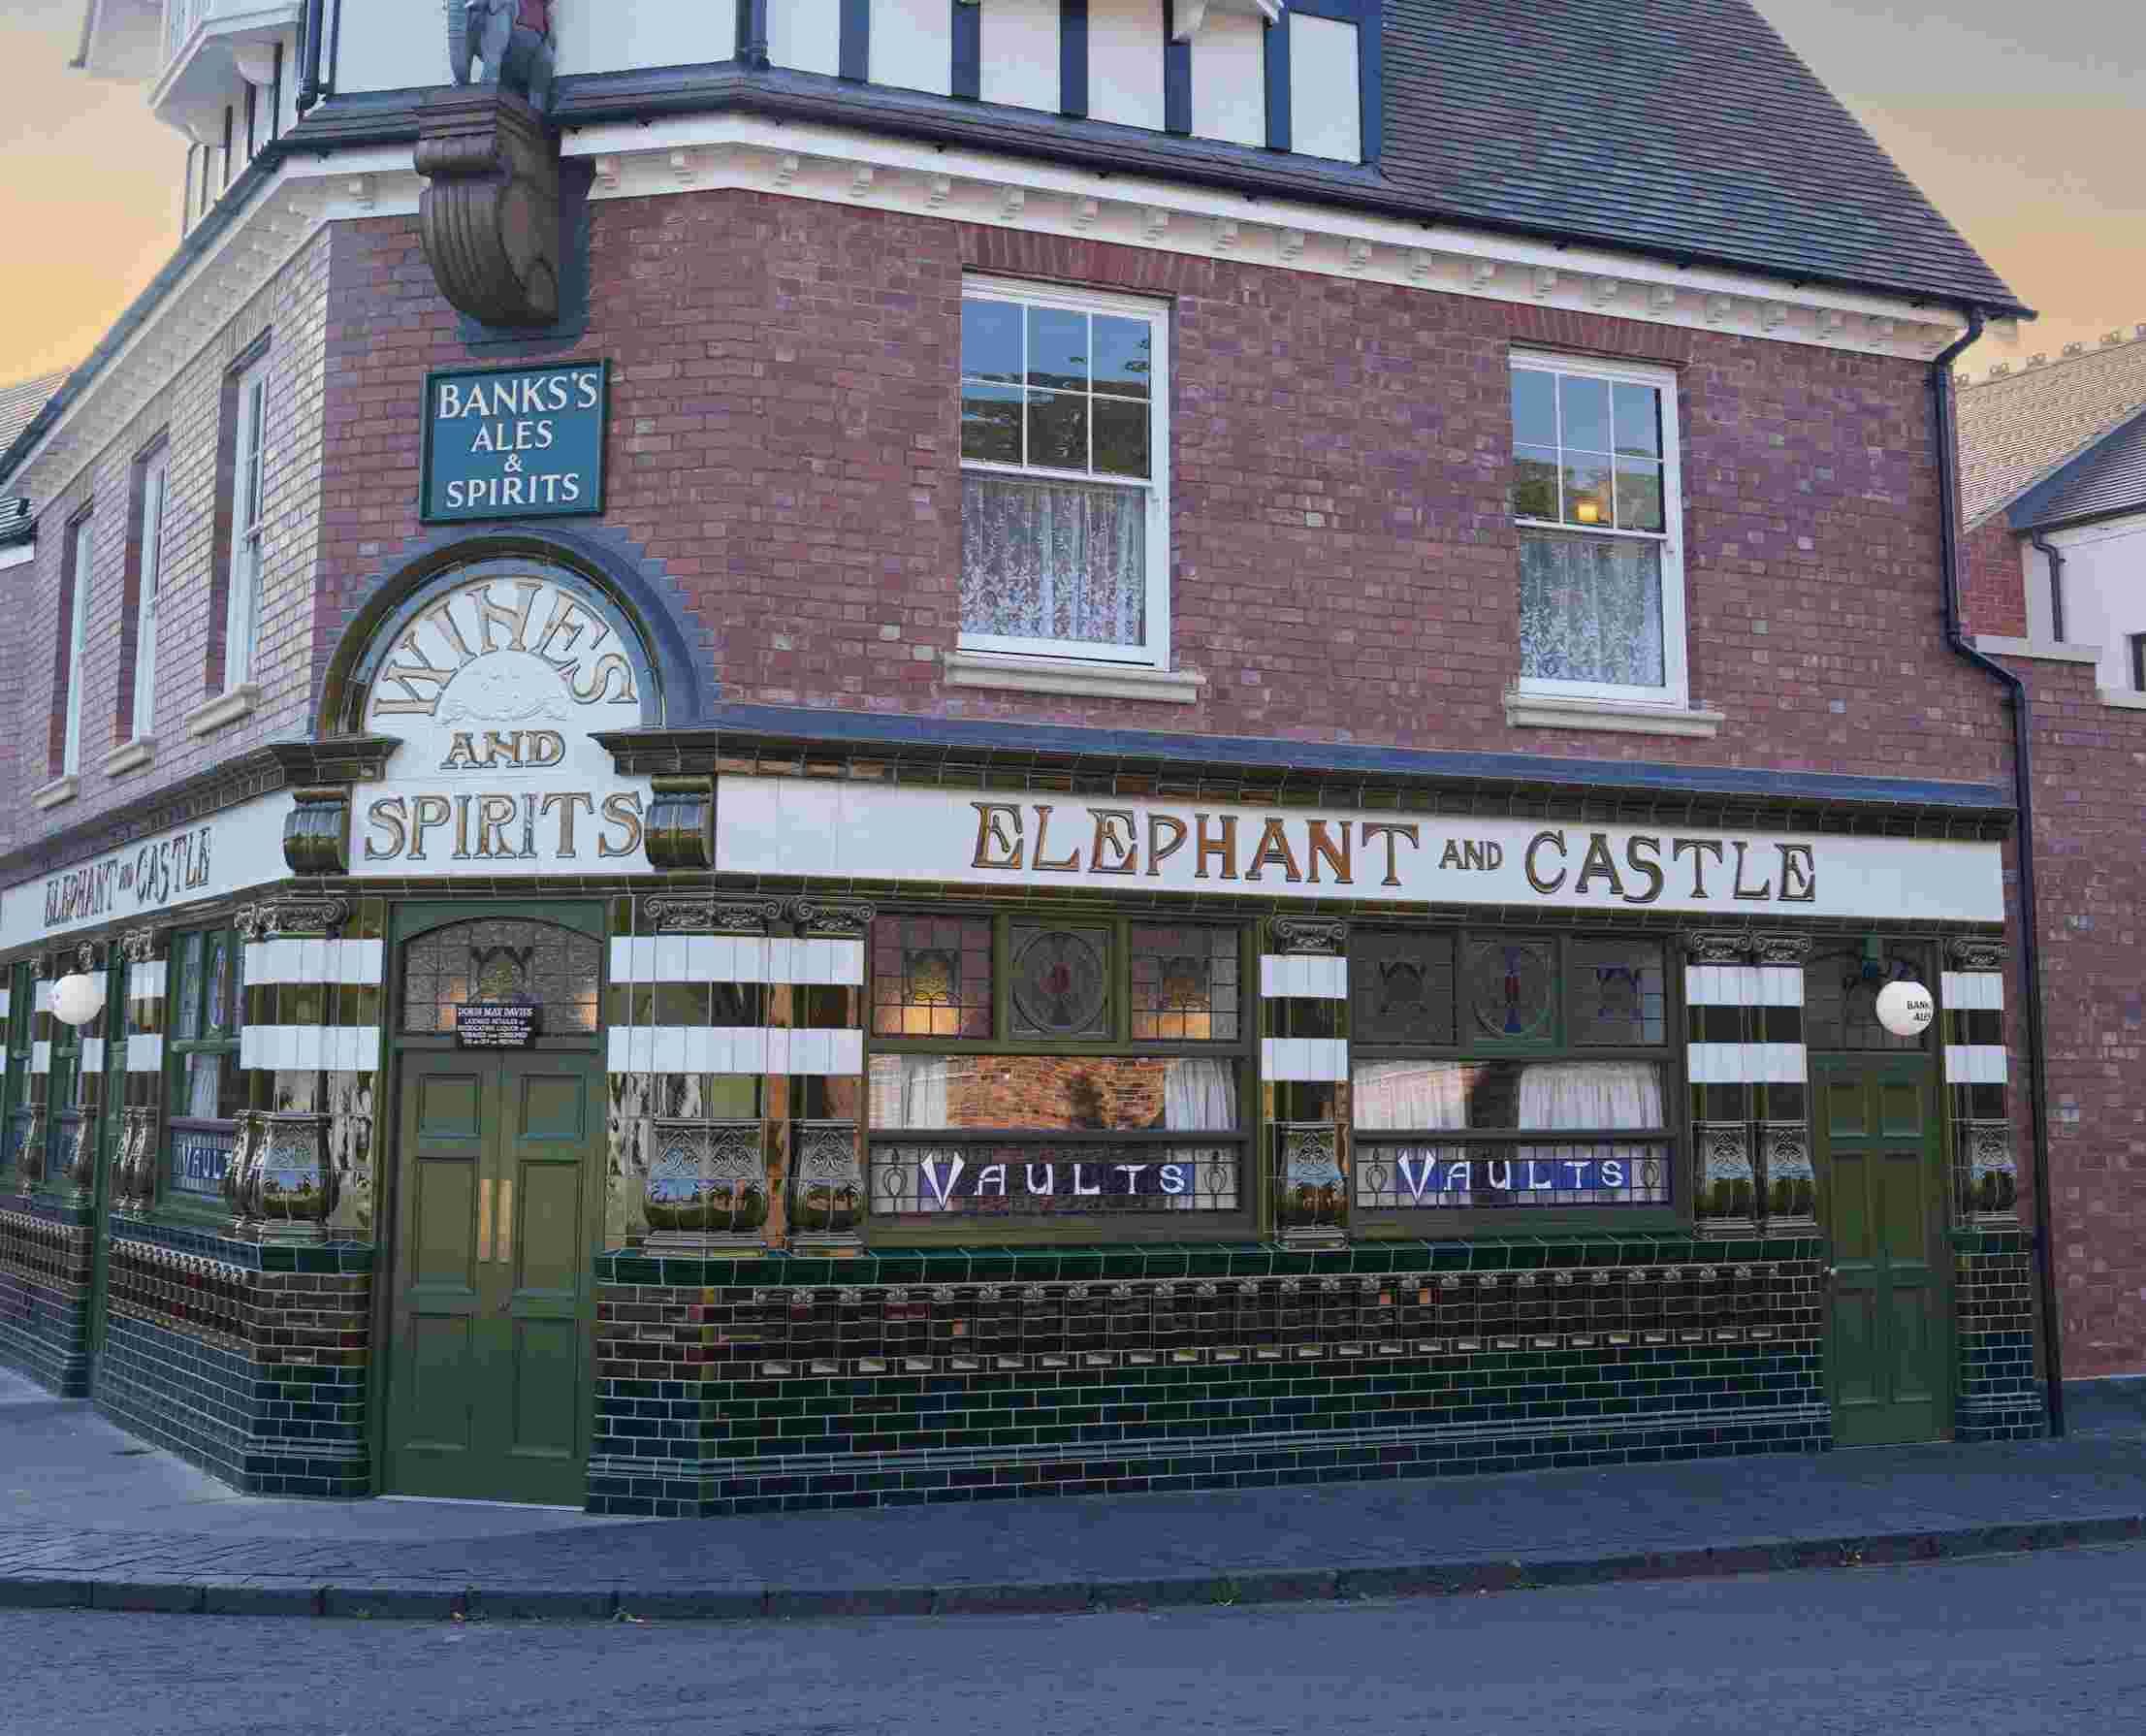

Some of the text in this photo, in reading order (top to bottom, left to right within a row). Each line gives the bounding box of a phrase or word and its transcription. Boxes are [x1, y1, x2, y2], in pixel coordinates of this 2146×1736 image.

[437, 371, 597, 419] BANKS'S
[470, 419, 554, 452] ALES
[503, 453, 524, 472] &
[445, 472, 581, 508] SPIRITS
[371, 582, 638, 718] WINES
[439, 729, 566, 769] AND
[364, 789, 644, 860] SPIRITS
[969, 800, 1816, 903] ELEPHANT AND CASTLE
[44, 857, 118, 928] ELEPHANT
[135, 825, 211, 905] CASTLE
[921, 1151, 1185, 1210] VAULTS
[1397, 1148, 1624, 1203] VAULTS
